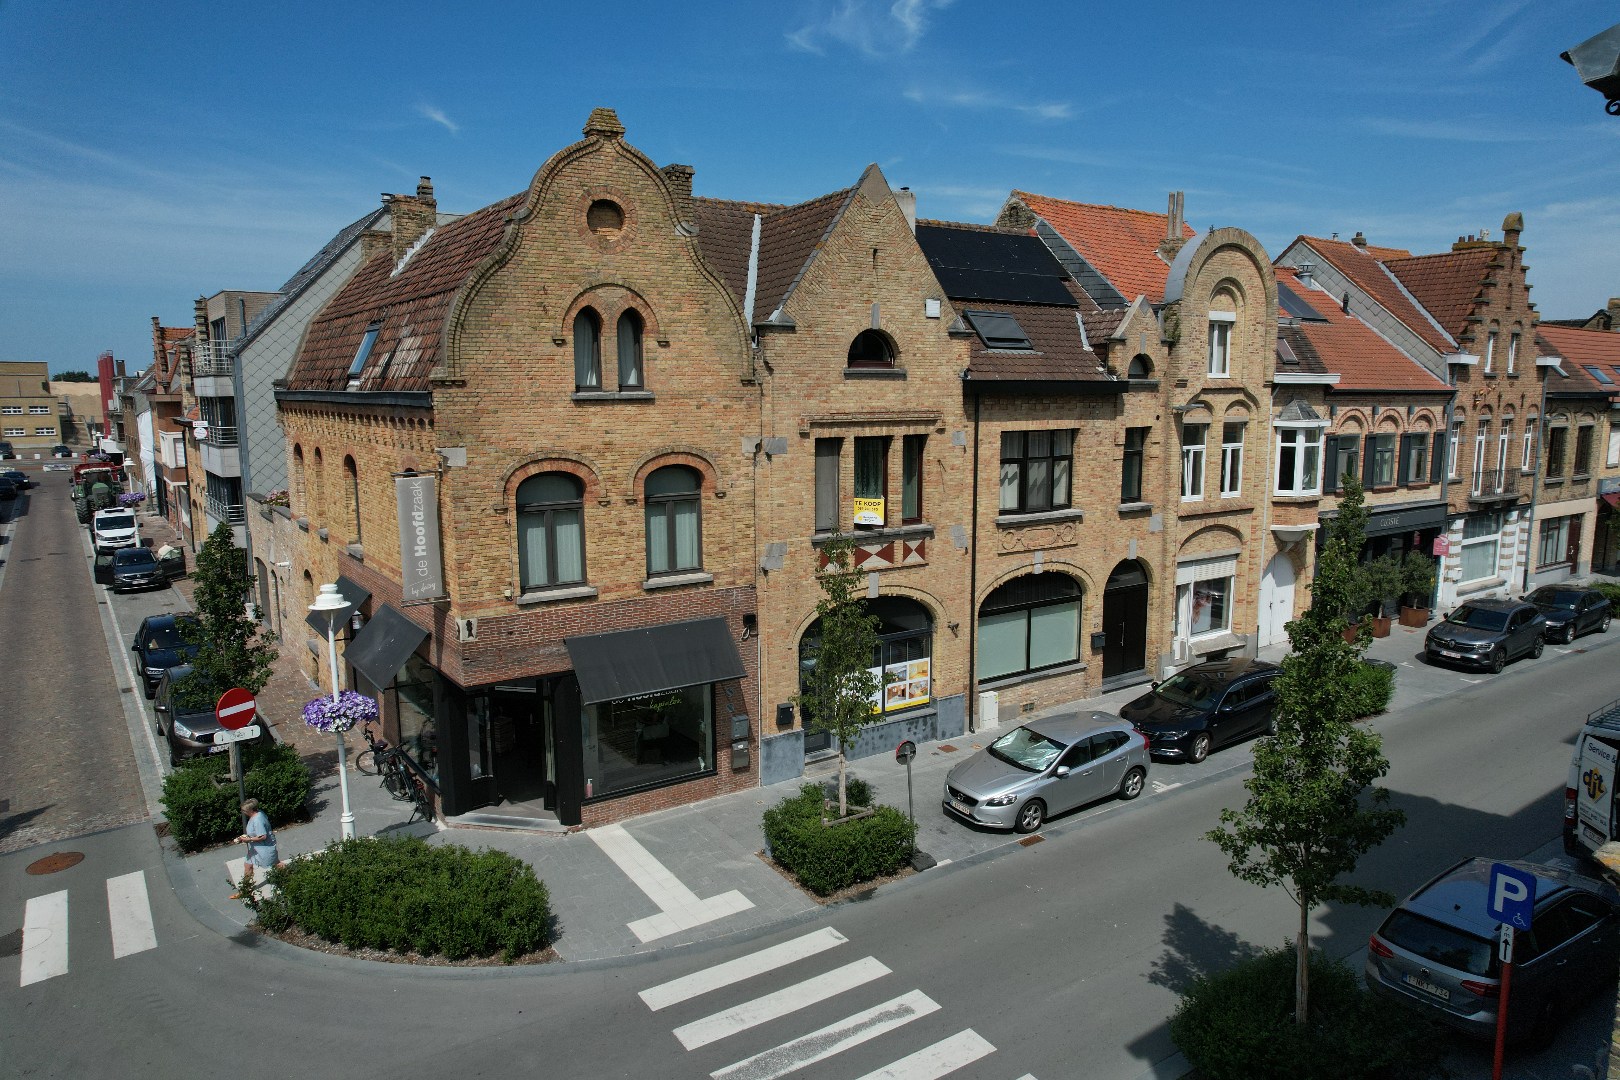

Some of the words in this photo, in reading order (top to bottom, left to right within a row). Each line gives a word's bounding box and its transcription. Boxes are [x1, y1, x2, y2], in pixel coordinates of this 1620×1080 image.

[410, 480, 427, 557] Hoofdzaak
[416, 560, 428, 577] de
[411, 587, 419, 597] by
[1588, 742, 1610, 761] Service
[1494, 872, 1528, 912] P
